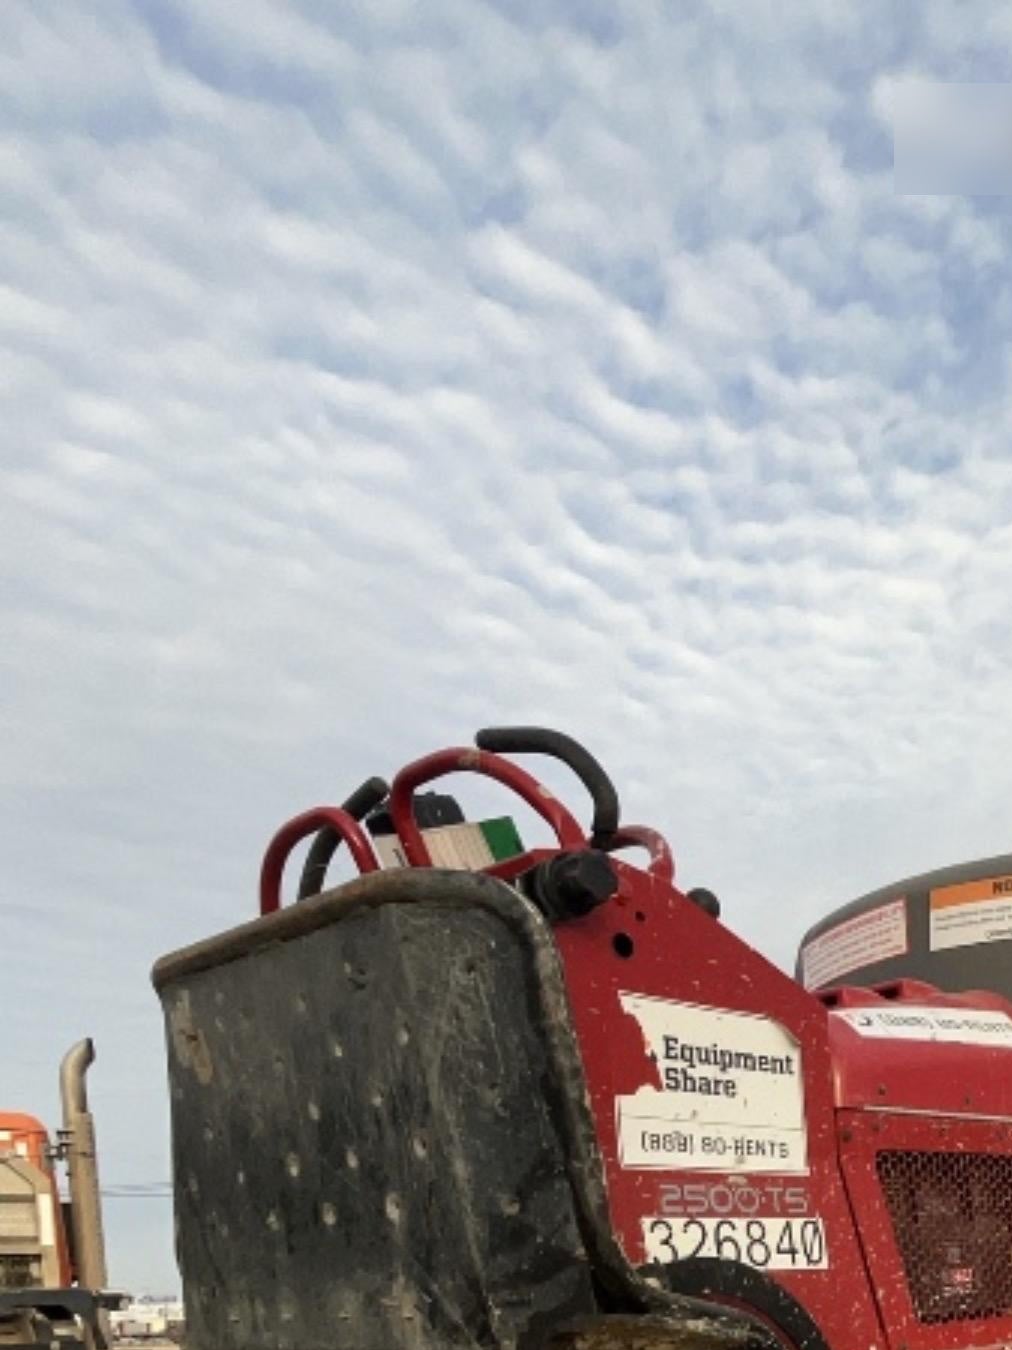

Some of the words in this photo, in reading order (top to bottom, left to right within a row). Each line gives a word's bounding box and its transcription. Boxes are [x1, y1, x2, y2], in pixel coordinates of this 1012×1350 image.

[663, 1035, 795, 1076] Equipment
[664, 1067, 737, 1098] Share
[649, 1220, 823, 1266] 326840
